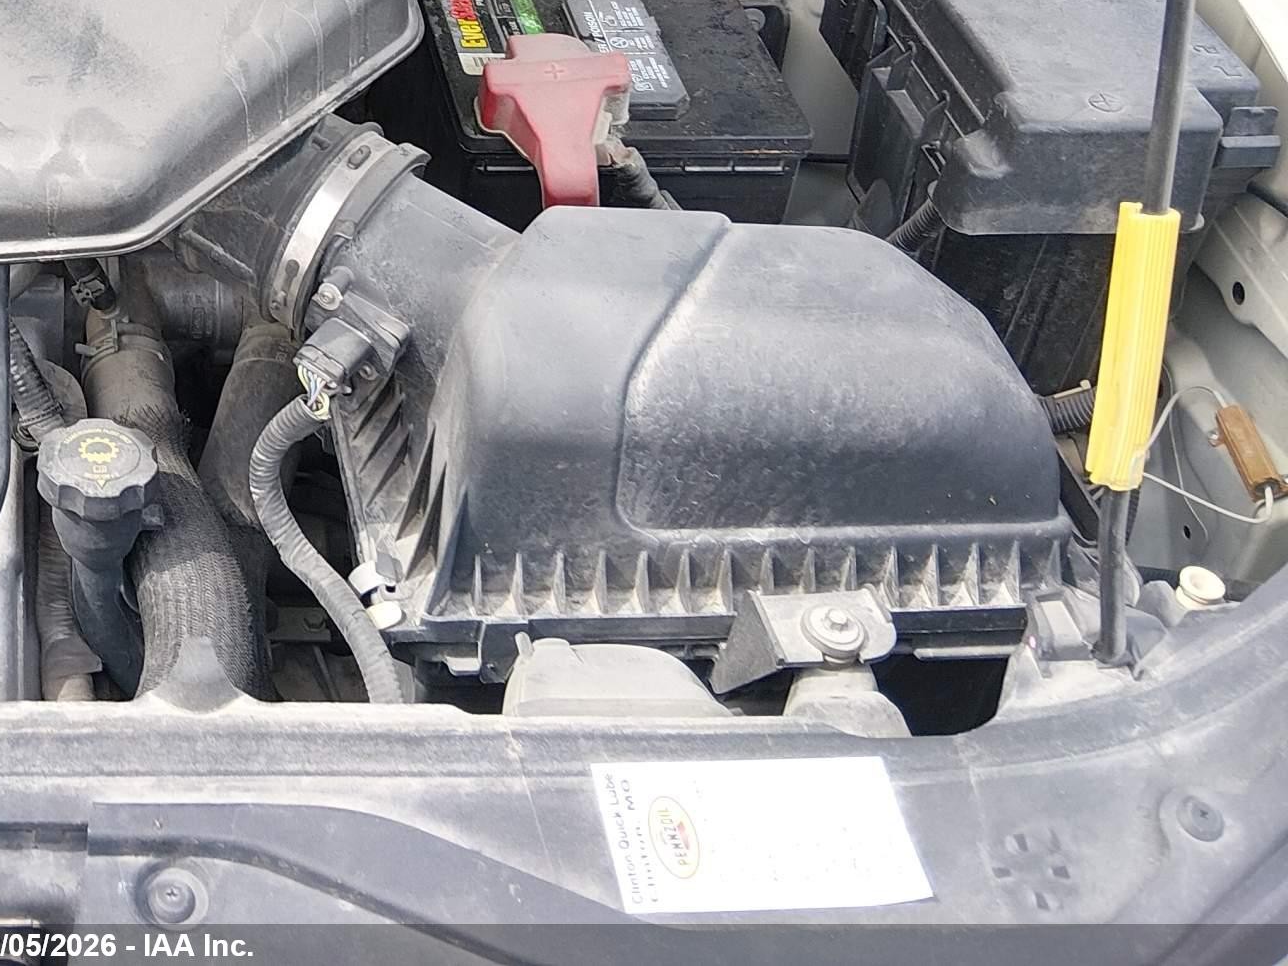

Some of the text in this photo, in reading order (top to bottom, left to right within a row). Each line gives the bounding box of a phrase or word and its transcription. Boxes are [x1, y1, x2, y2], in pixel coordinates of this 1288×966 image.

[584, 11, 603, 38] POISON
[604, 774, 643, 904] Clinton Quick Lube
[655, 807, 689, 866] PENNZOIL
